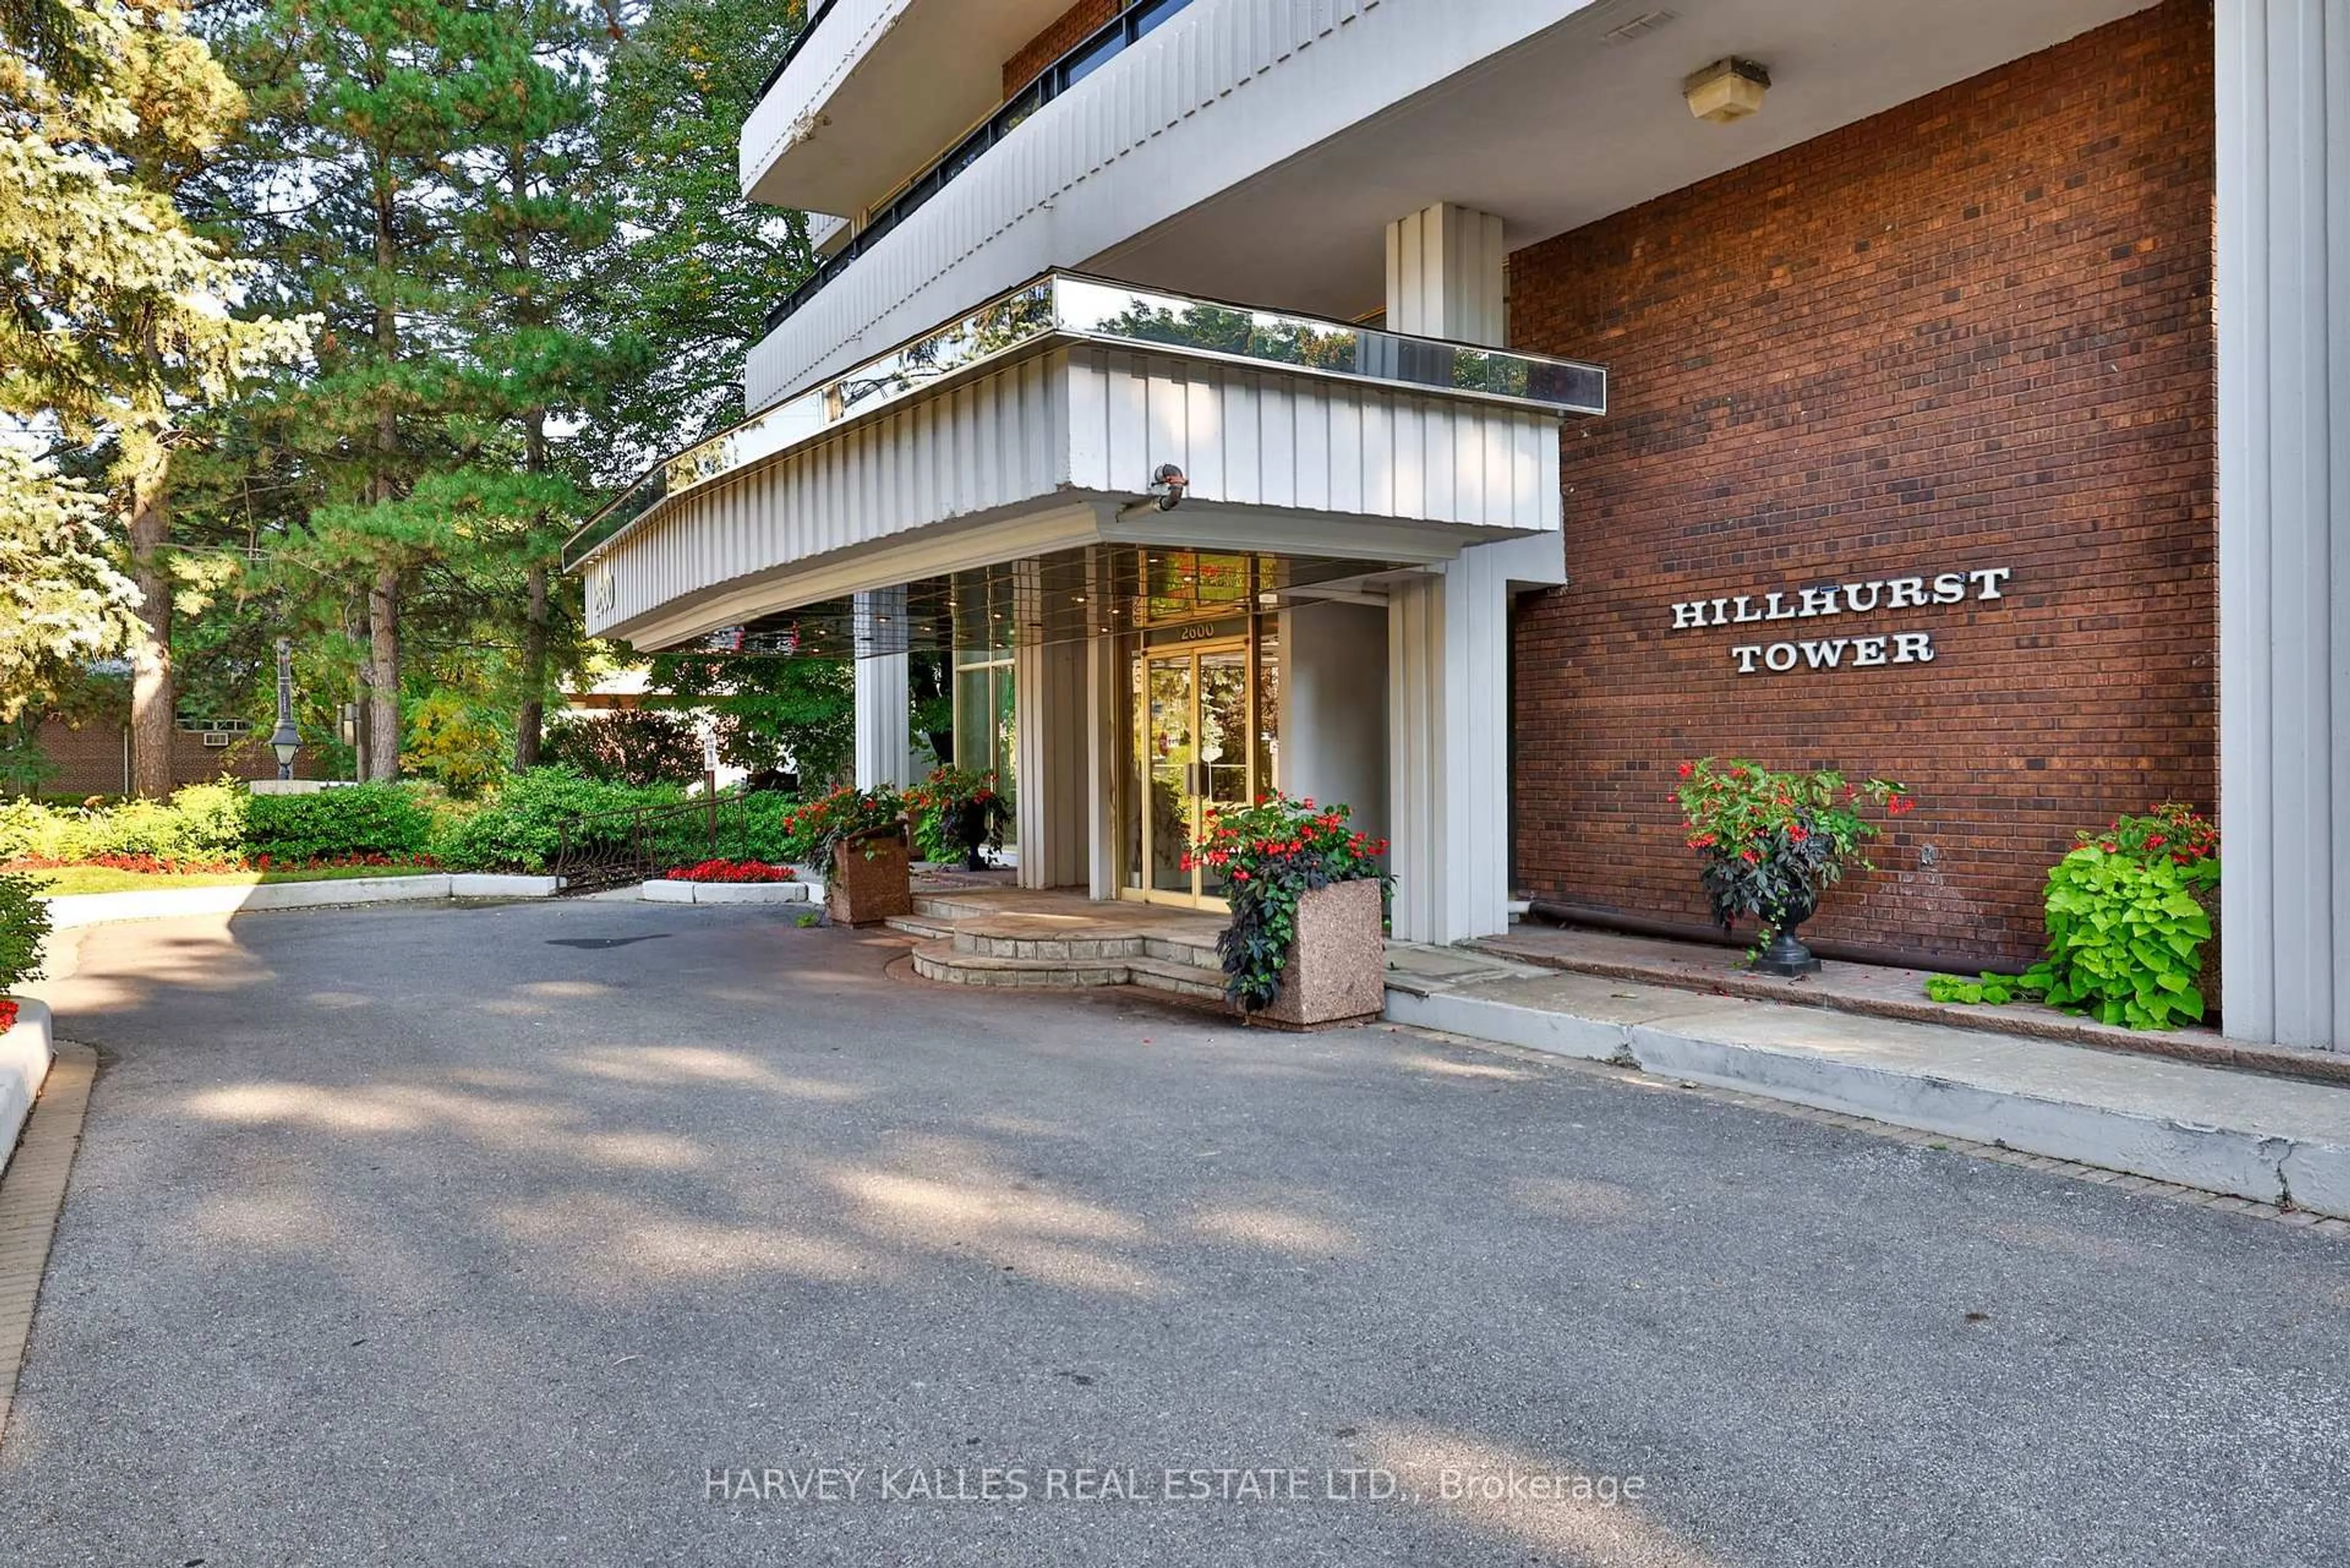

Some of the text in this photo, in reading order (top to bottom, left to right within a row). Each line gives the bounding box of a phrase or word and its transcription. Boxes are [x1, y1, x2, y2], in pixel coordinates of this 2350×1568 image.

[1671, 567, 2010, 629] HILLHURST
[1181, 621, 1215, 641] 2600
[1731, 632, 1935, 673] TOWER
